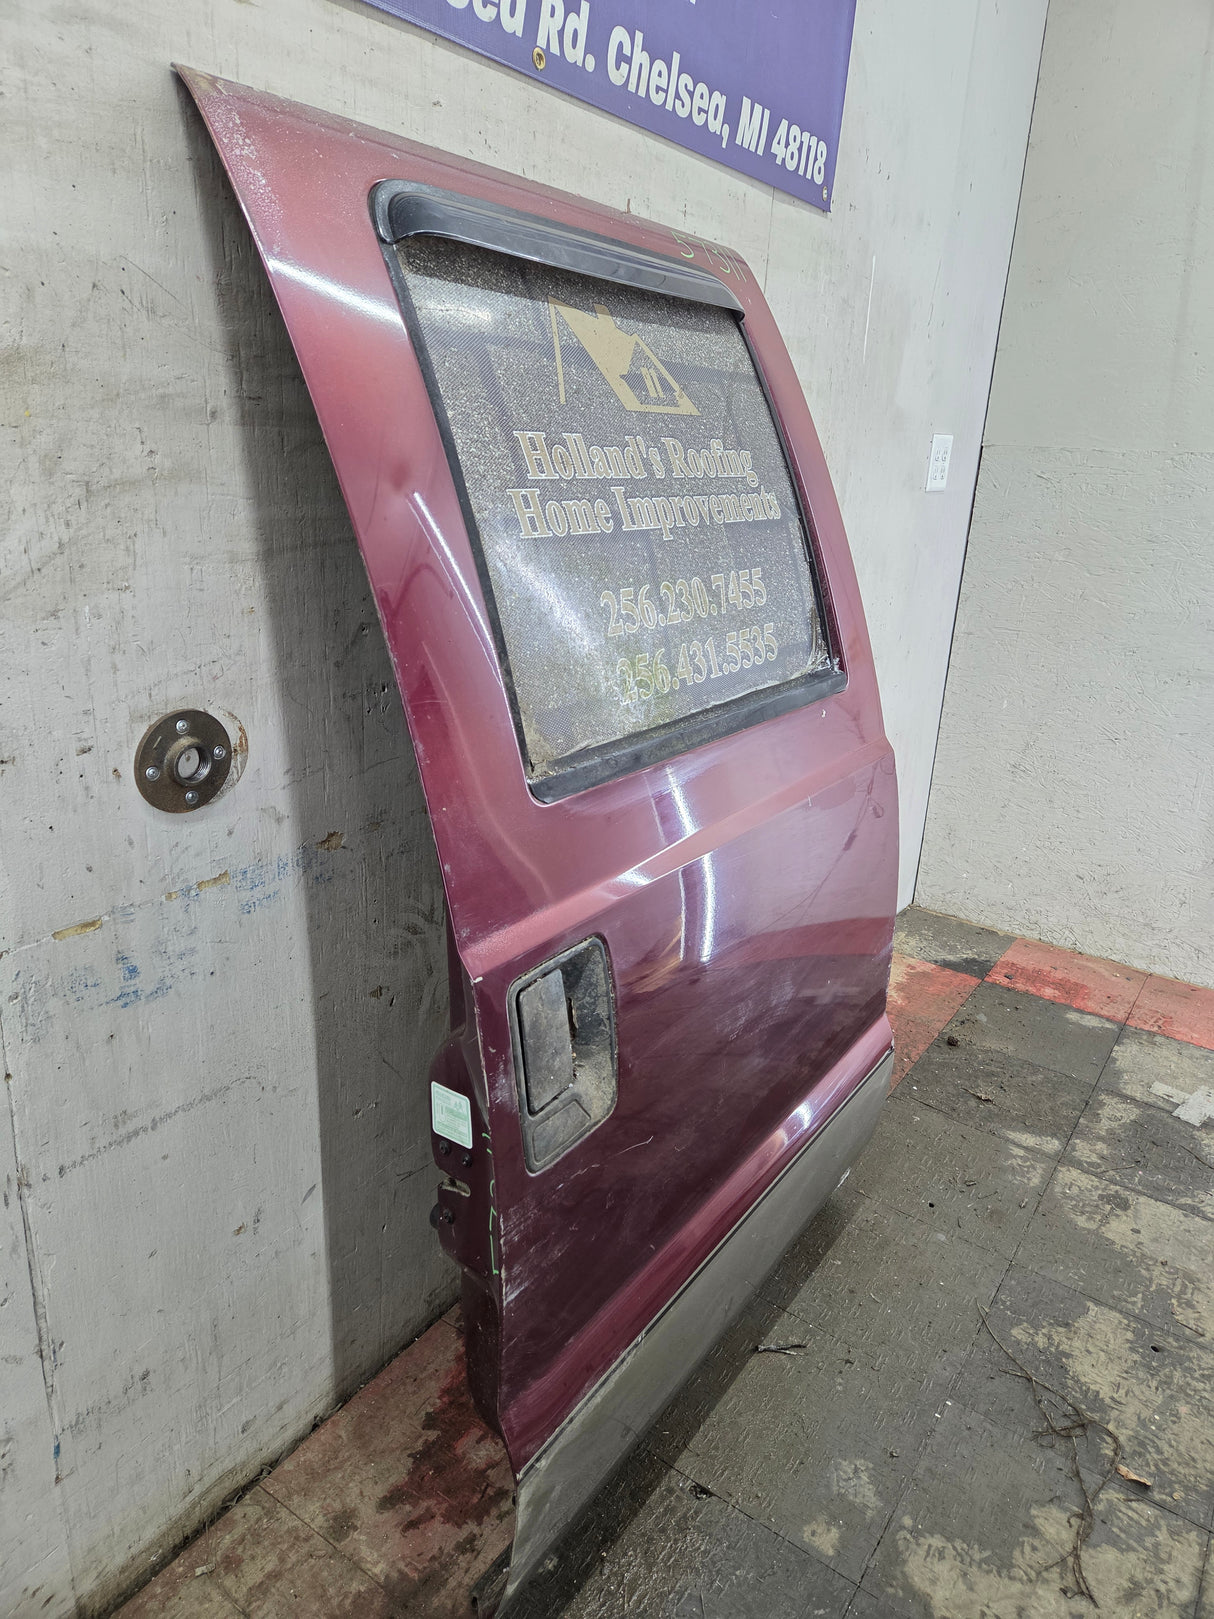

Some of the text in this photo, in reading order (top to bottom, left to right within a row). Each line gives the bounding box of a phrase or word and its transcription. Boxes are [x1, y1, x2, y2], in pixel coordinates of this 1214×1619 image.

[536, 0, 596, 73] Rd.
[607, 25, 730, 149] Chelsea,
[735, 95, 770, 157] MI
[770, 118, 828, 185] 48118
[513, 431, 759, 487] Holland's Roofing
[506, 486, 782, 540] Home Improvements
[600, 568, 767, 637] 256.230.7455
[616, 623, 779, 704] 256.431.5535
